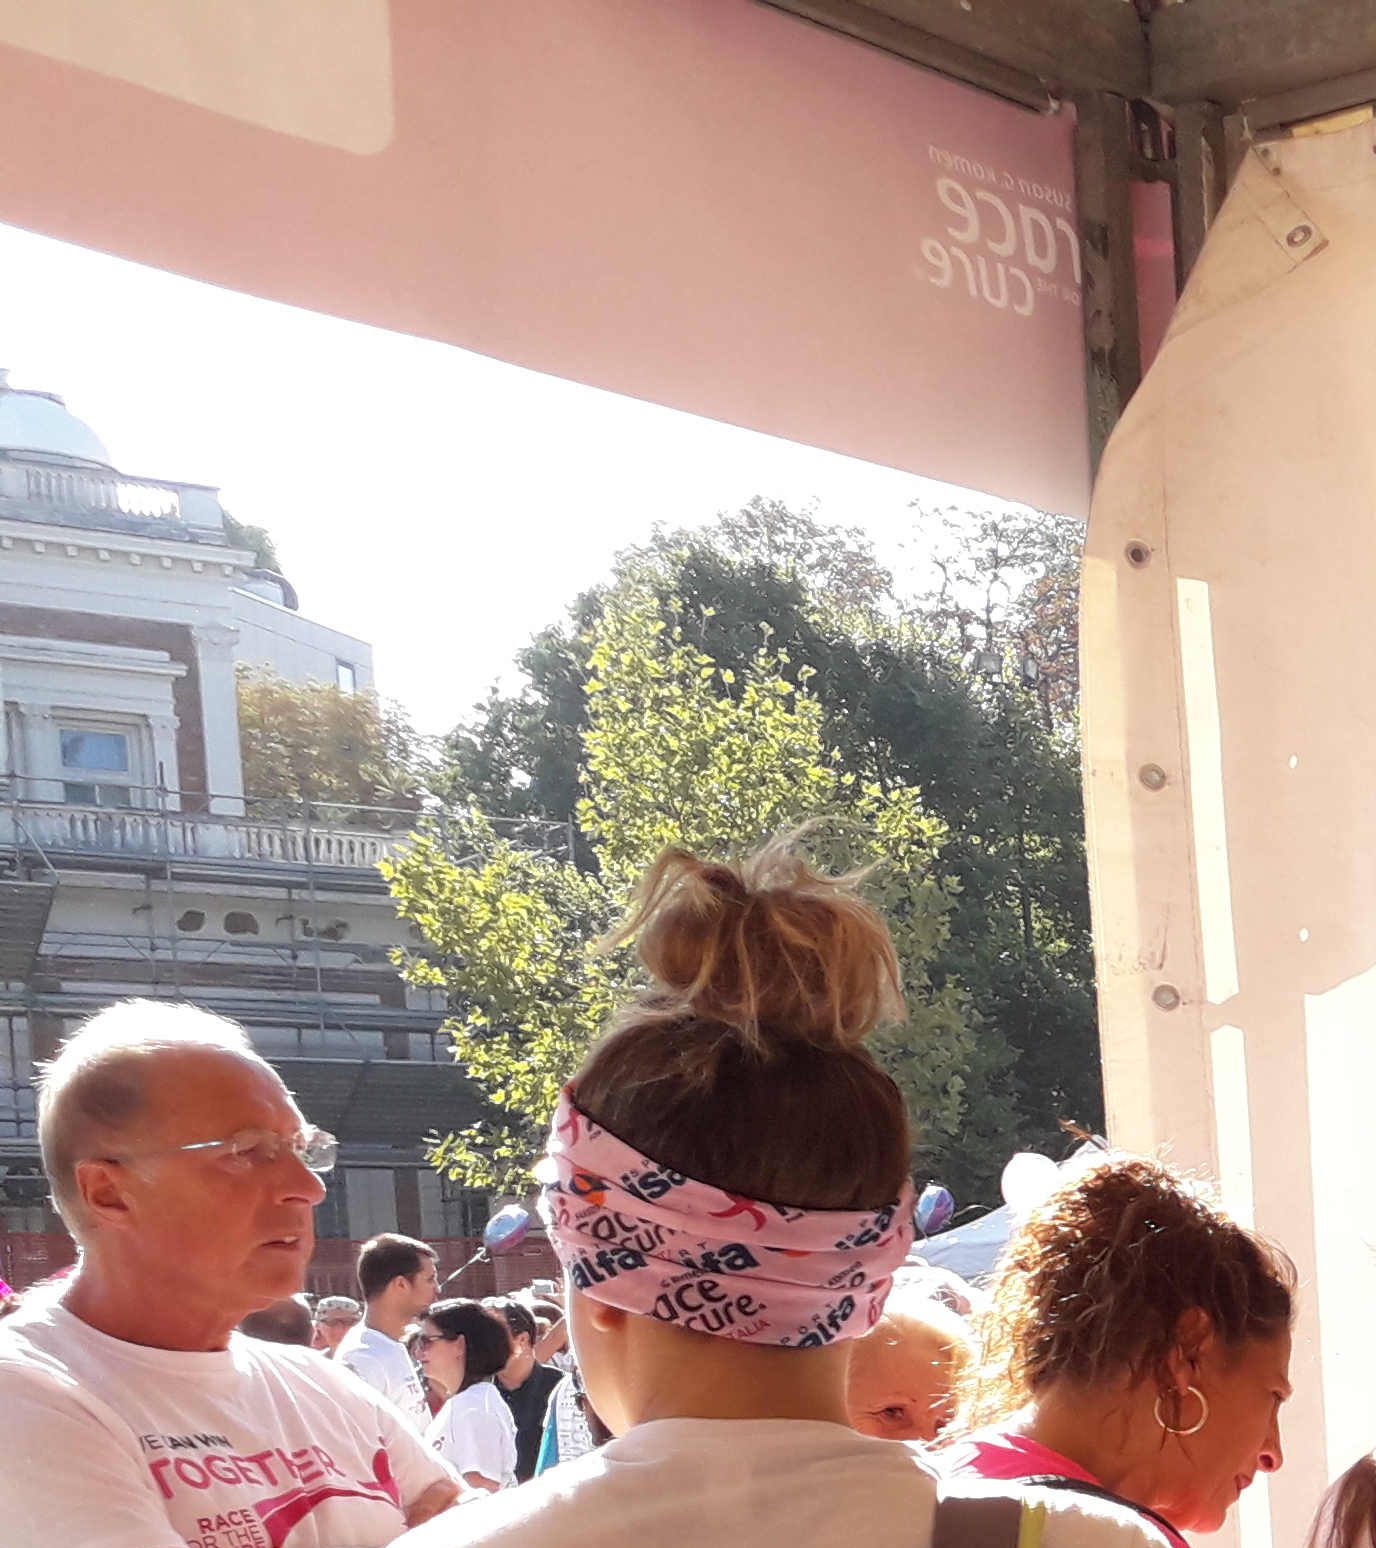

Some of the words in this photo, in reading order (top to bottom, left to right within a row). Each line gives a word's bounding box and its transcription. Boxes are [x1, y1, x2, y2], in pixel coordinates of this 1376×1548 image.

[148, 1445, 347, 1500] TOGETHER
[196, 1508, 256, 1534] RACE
[222, 1524, 265, 1548] THE
